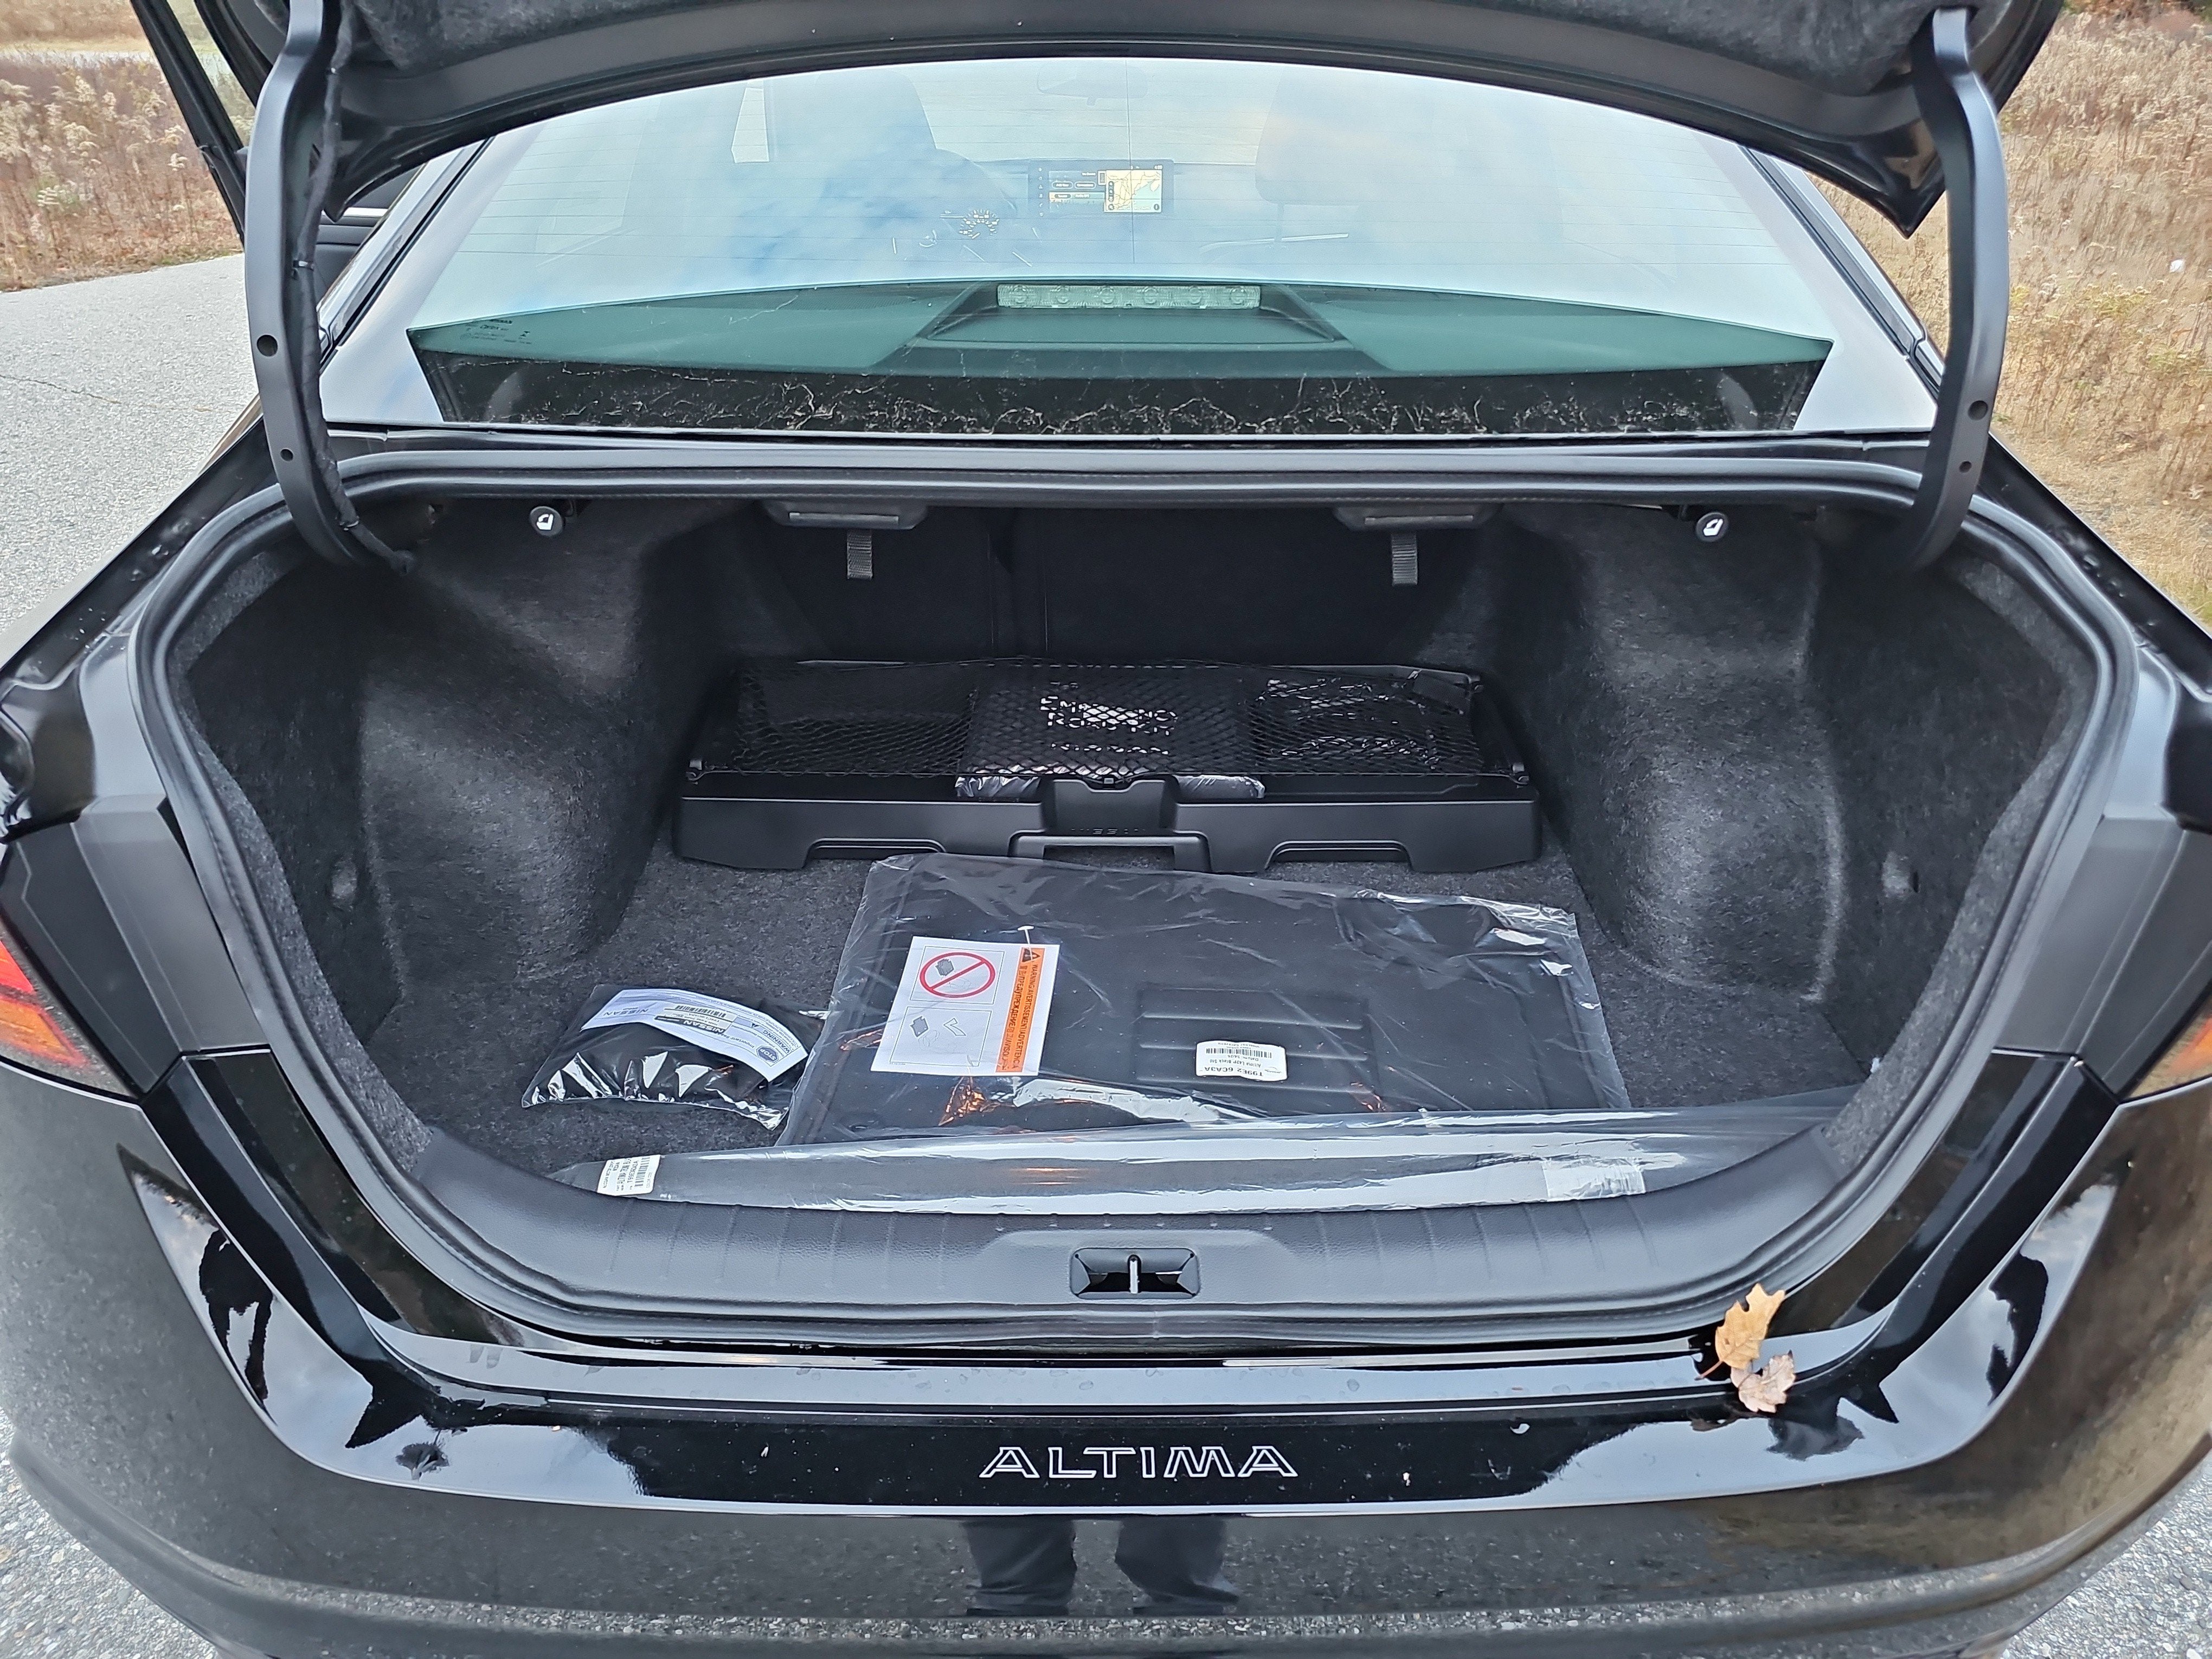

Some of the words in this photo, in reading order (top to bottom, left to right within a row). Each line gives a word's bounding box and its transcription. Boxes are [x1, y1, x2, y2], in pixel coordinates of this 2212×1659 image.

[683, 1020, 724, 1033] NISSAN
[763, 1030, 790, 1053] WARNING
[760, 1049, 776, 1060] STOP
[979, 1446, 1298, 1478] ALTIMA
